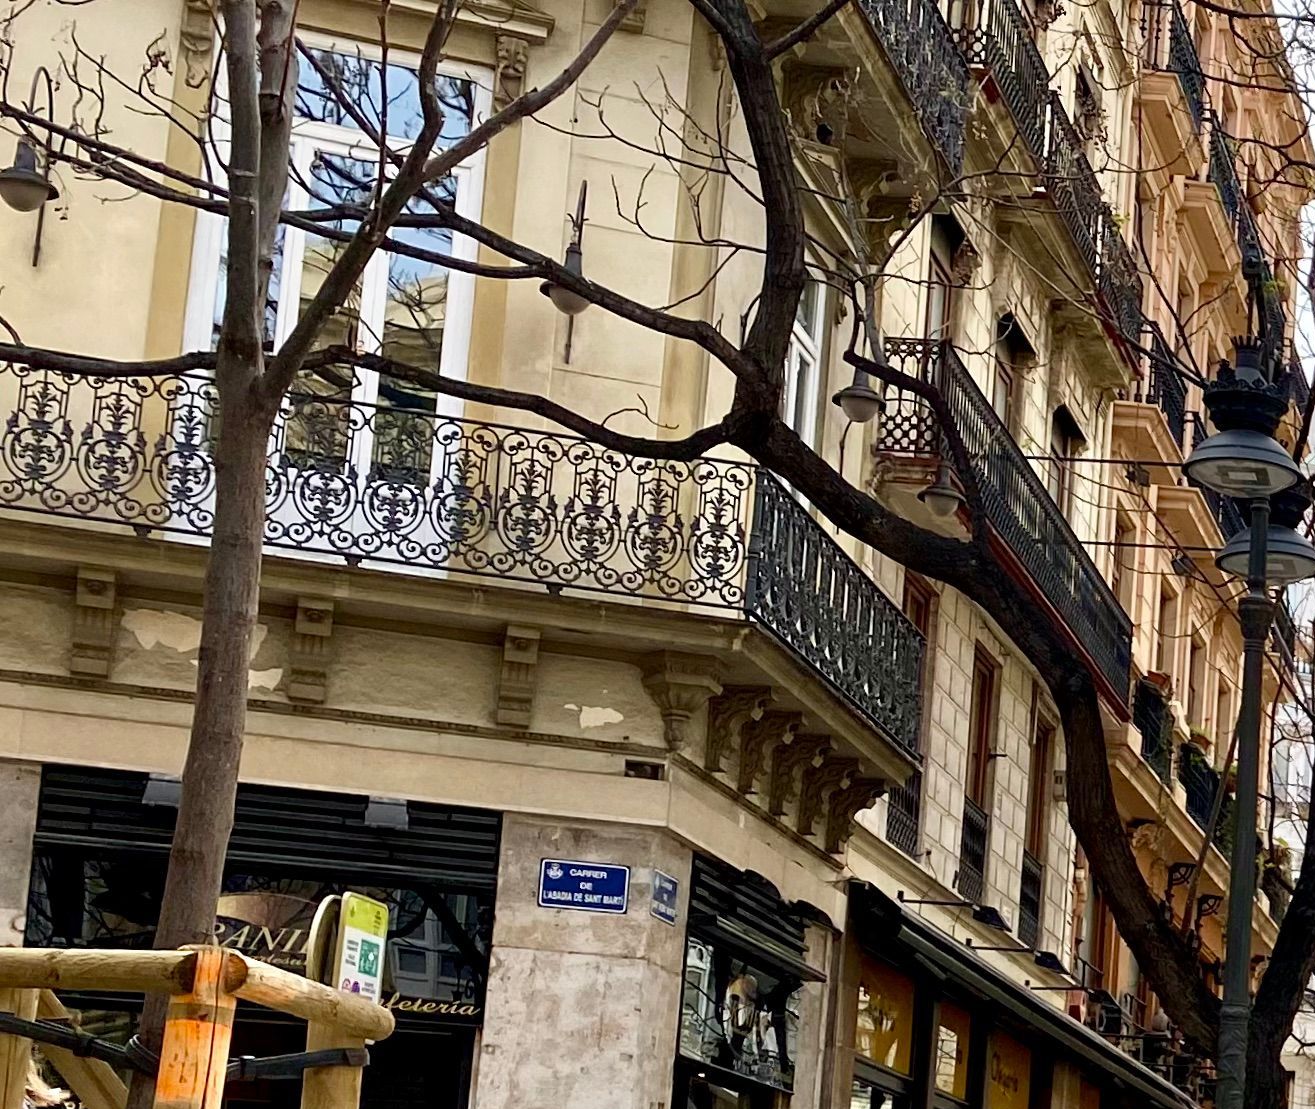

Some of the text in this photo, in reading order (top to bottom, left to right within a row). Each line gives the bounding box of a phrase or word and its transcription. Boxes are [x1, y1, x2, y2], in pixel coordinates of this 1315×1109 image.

[569, 868, 608, 879] CARRER
[579, 882, 593, 891] DE
[573, 892, 583, 902] DE
[583, 894, 602, 904] SANT
